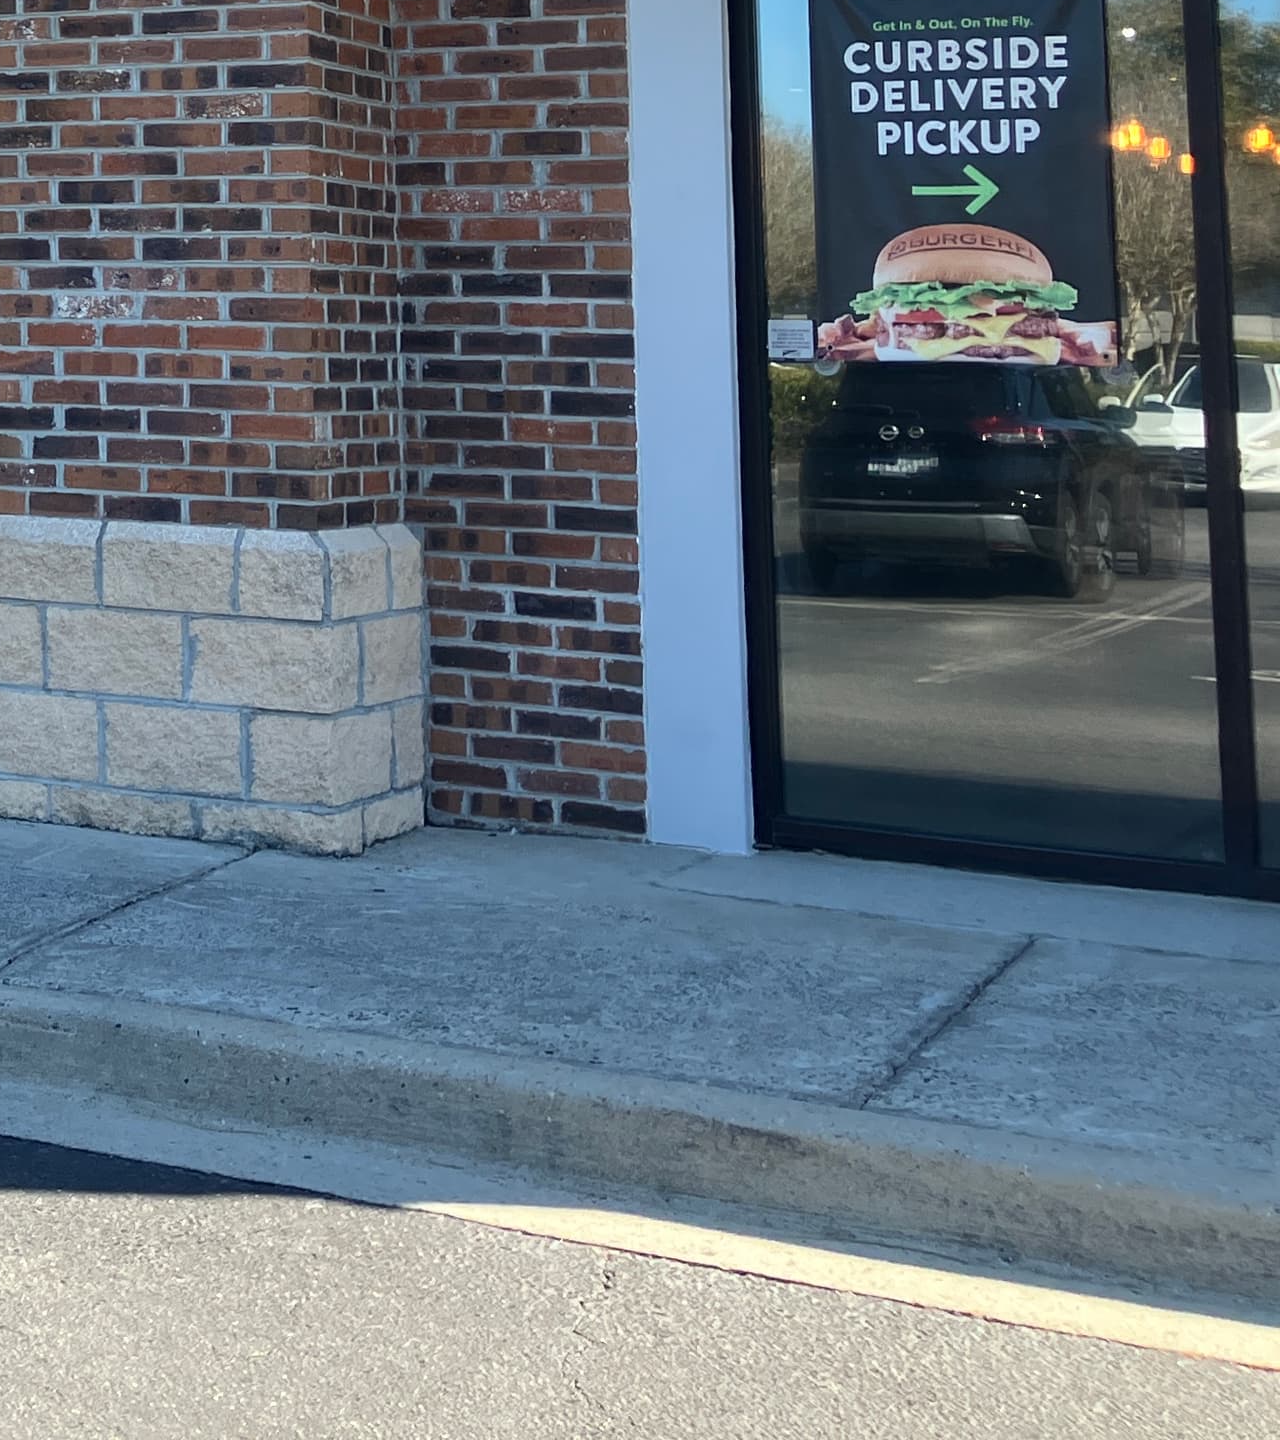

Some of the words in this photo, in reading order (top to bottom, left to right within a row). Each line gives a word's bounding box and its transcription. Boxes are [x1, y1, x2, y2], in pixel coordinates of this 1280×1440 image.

[872, 22, 896, 32] Get
[899, 20, 912, 31] In
[915, 20, 926, 30] &
[960, 18, 981, 29] On
[984, 17, 1009, 28] The
[1012, 15, 1034, 30] Fly.
[843, 35, 1069, 74] CURBSIDE
[850, 76, 1068, 113] DELIVERY
[877, 118, 1041, 156] PICKUP
[909, 233, 1034, 258] BURGERFI
